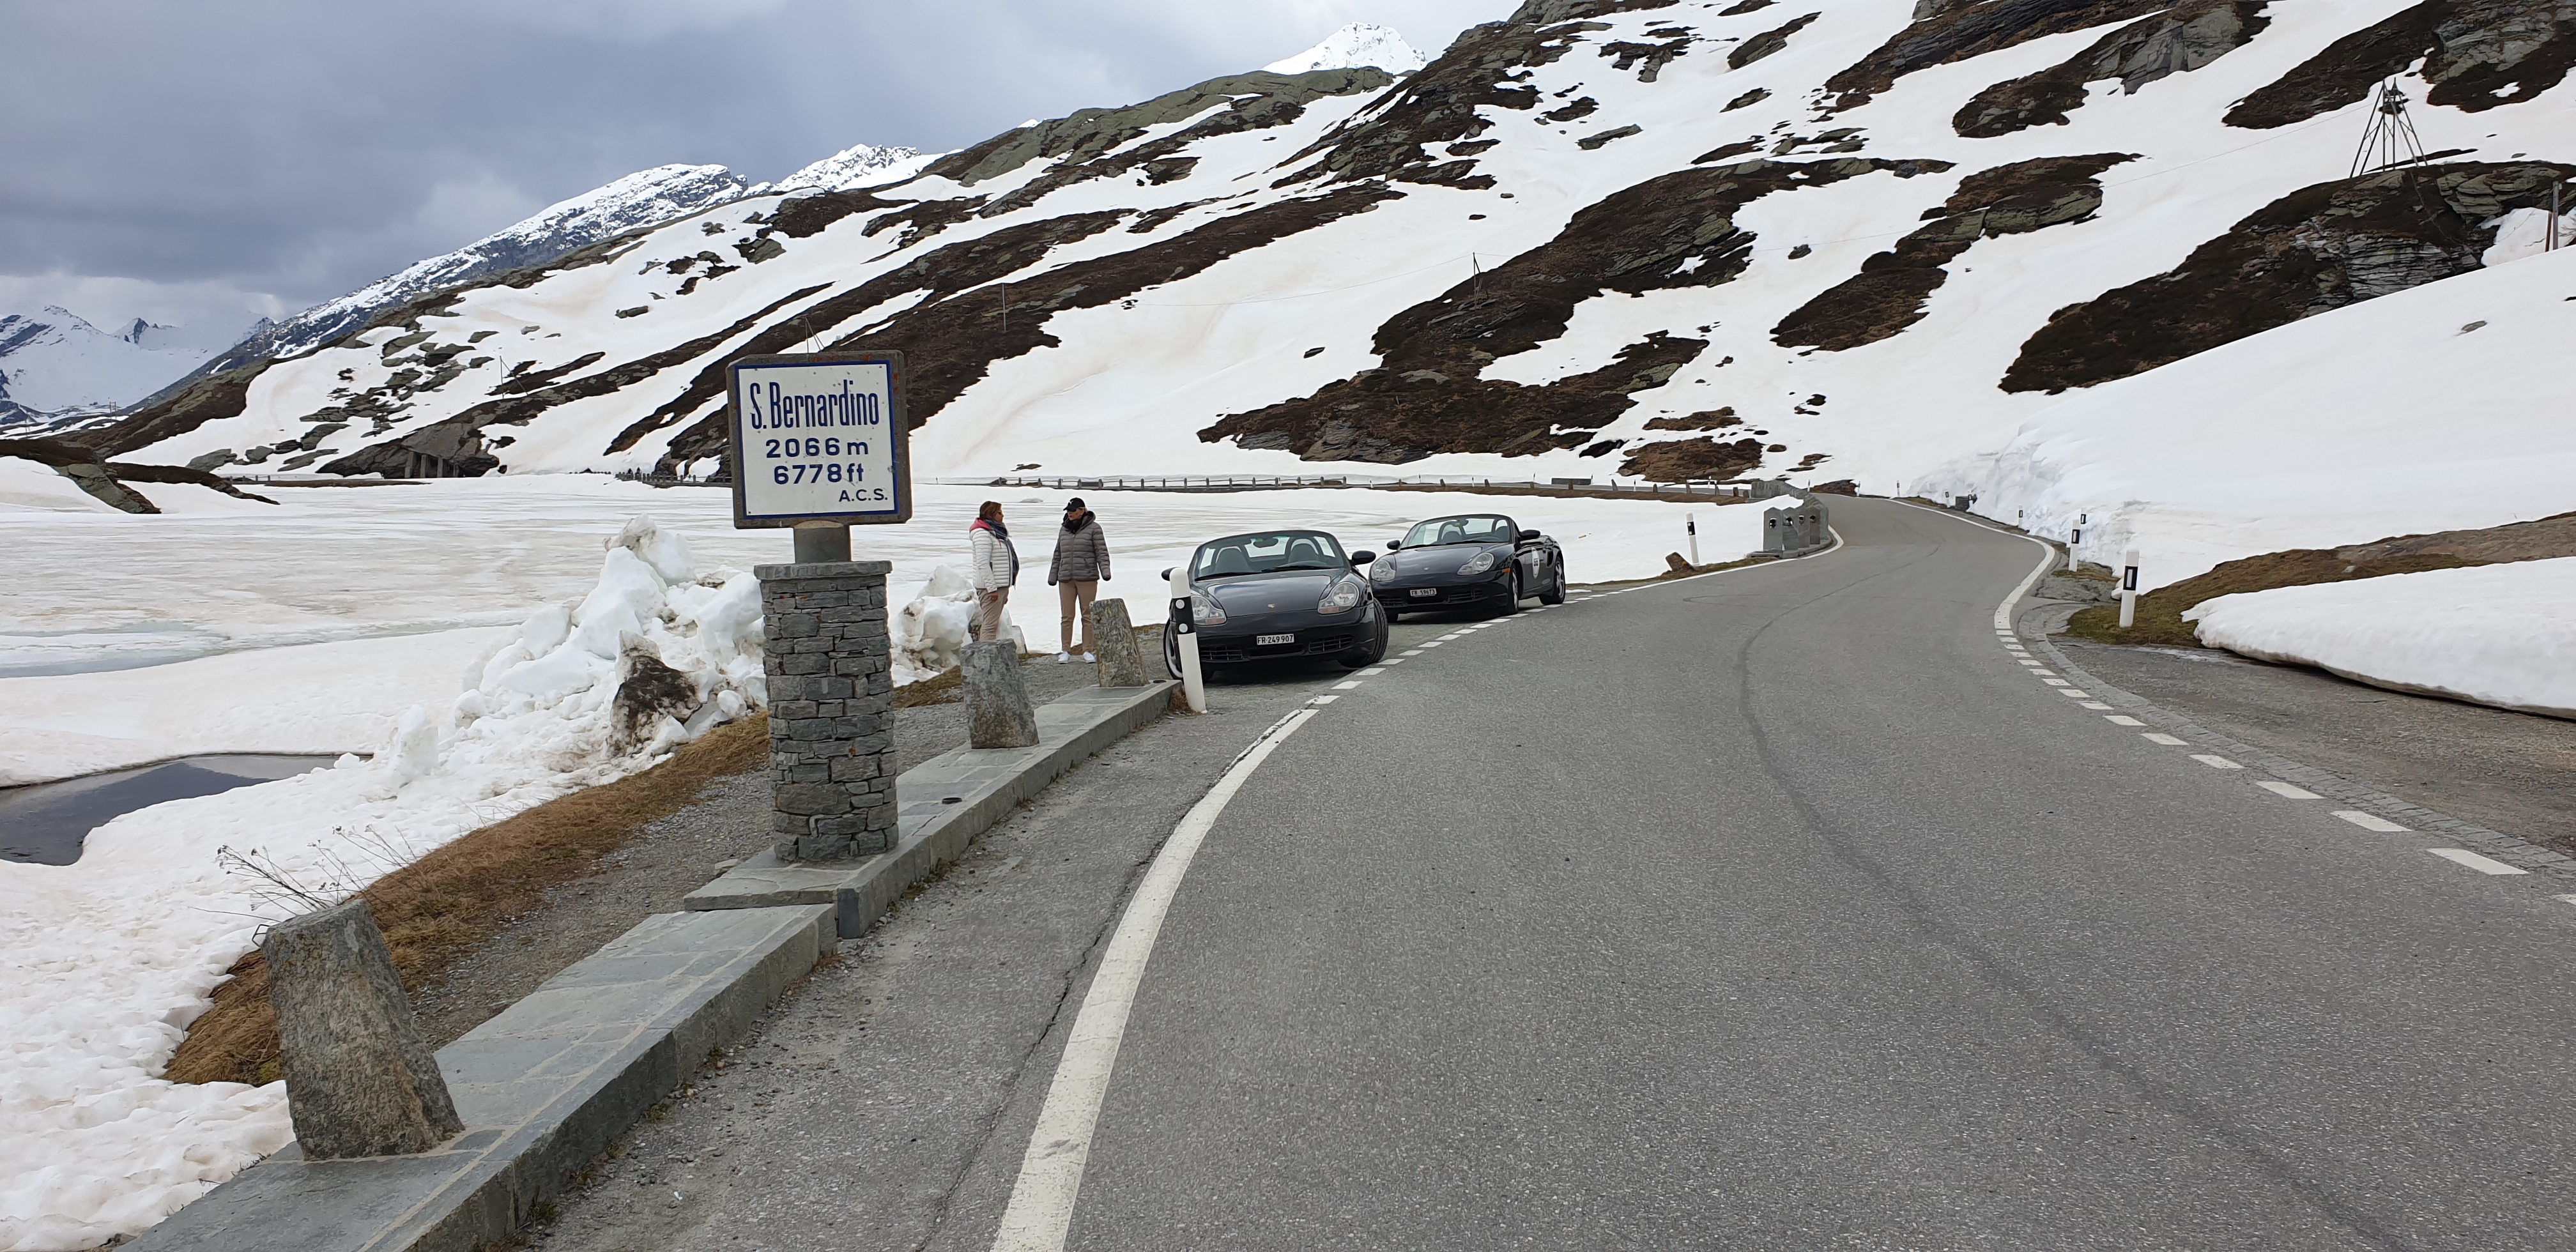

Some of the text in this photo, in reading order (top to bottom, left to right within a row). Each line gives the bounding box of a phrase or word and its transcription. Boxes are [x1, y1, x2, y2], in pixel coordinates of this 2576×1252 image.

[766, 438, 868, 458] 2066 m
[774, 463, 864, 484] 6778 ft
[839, 488, 887, 502] A.C.S.
